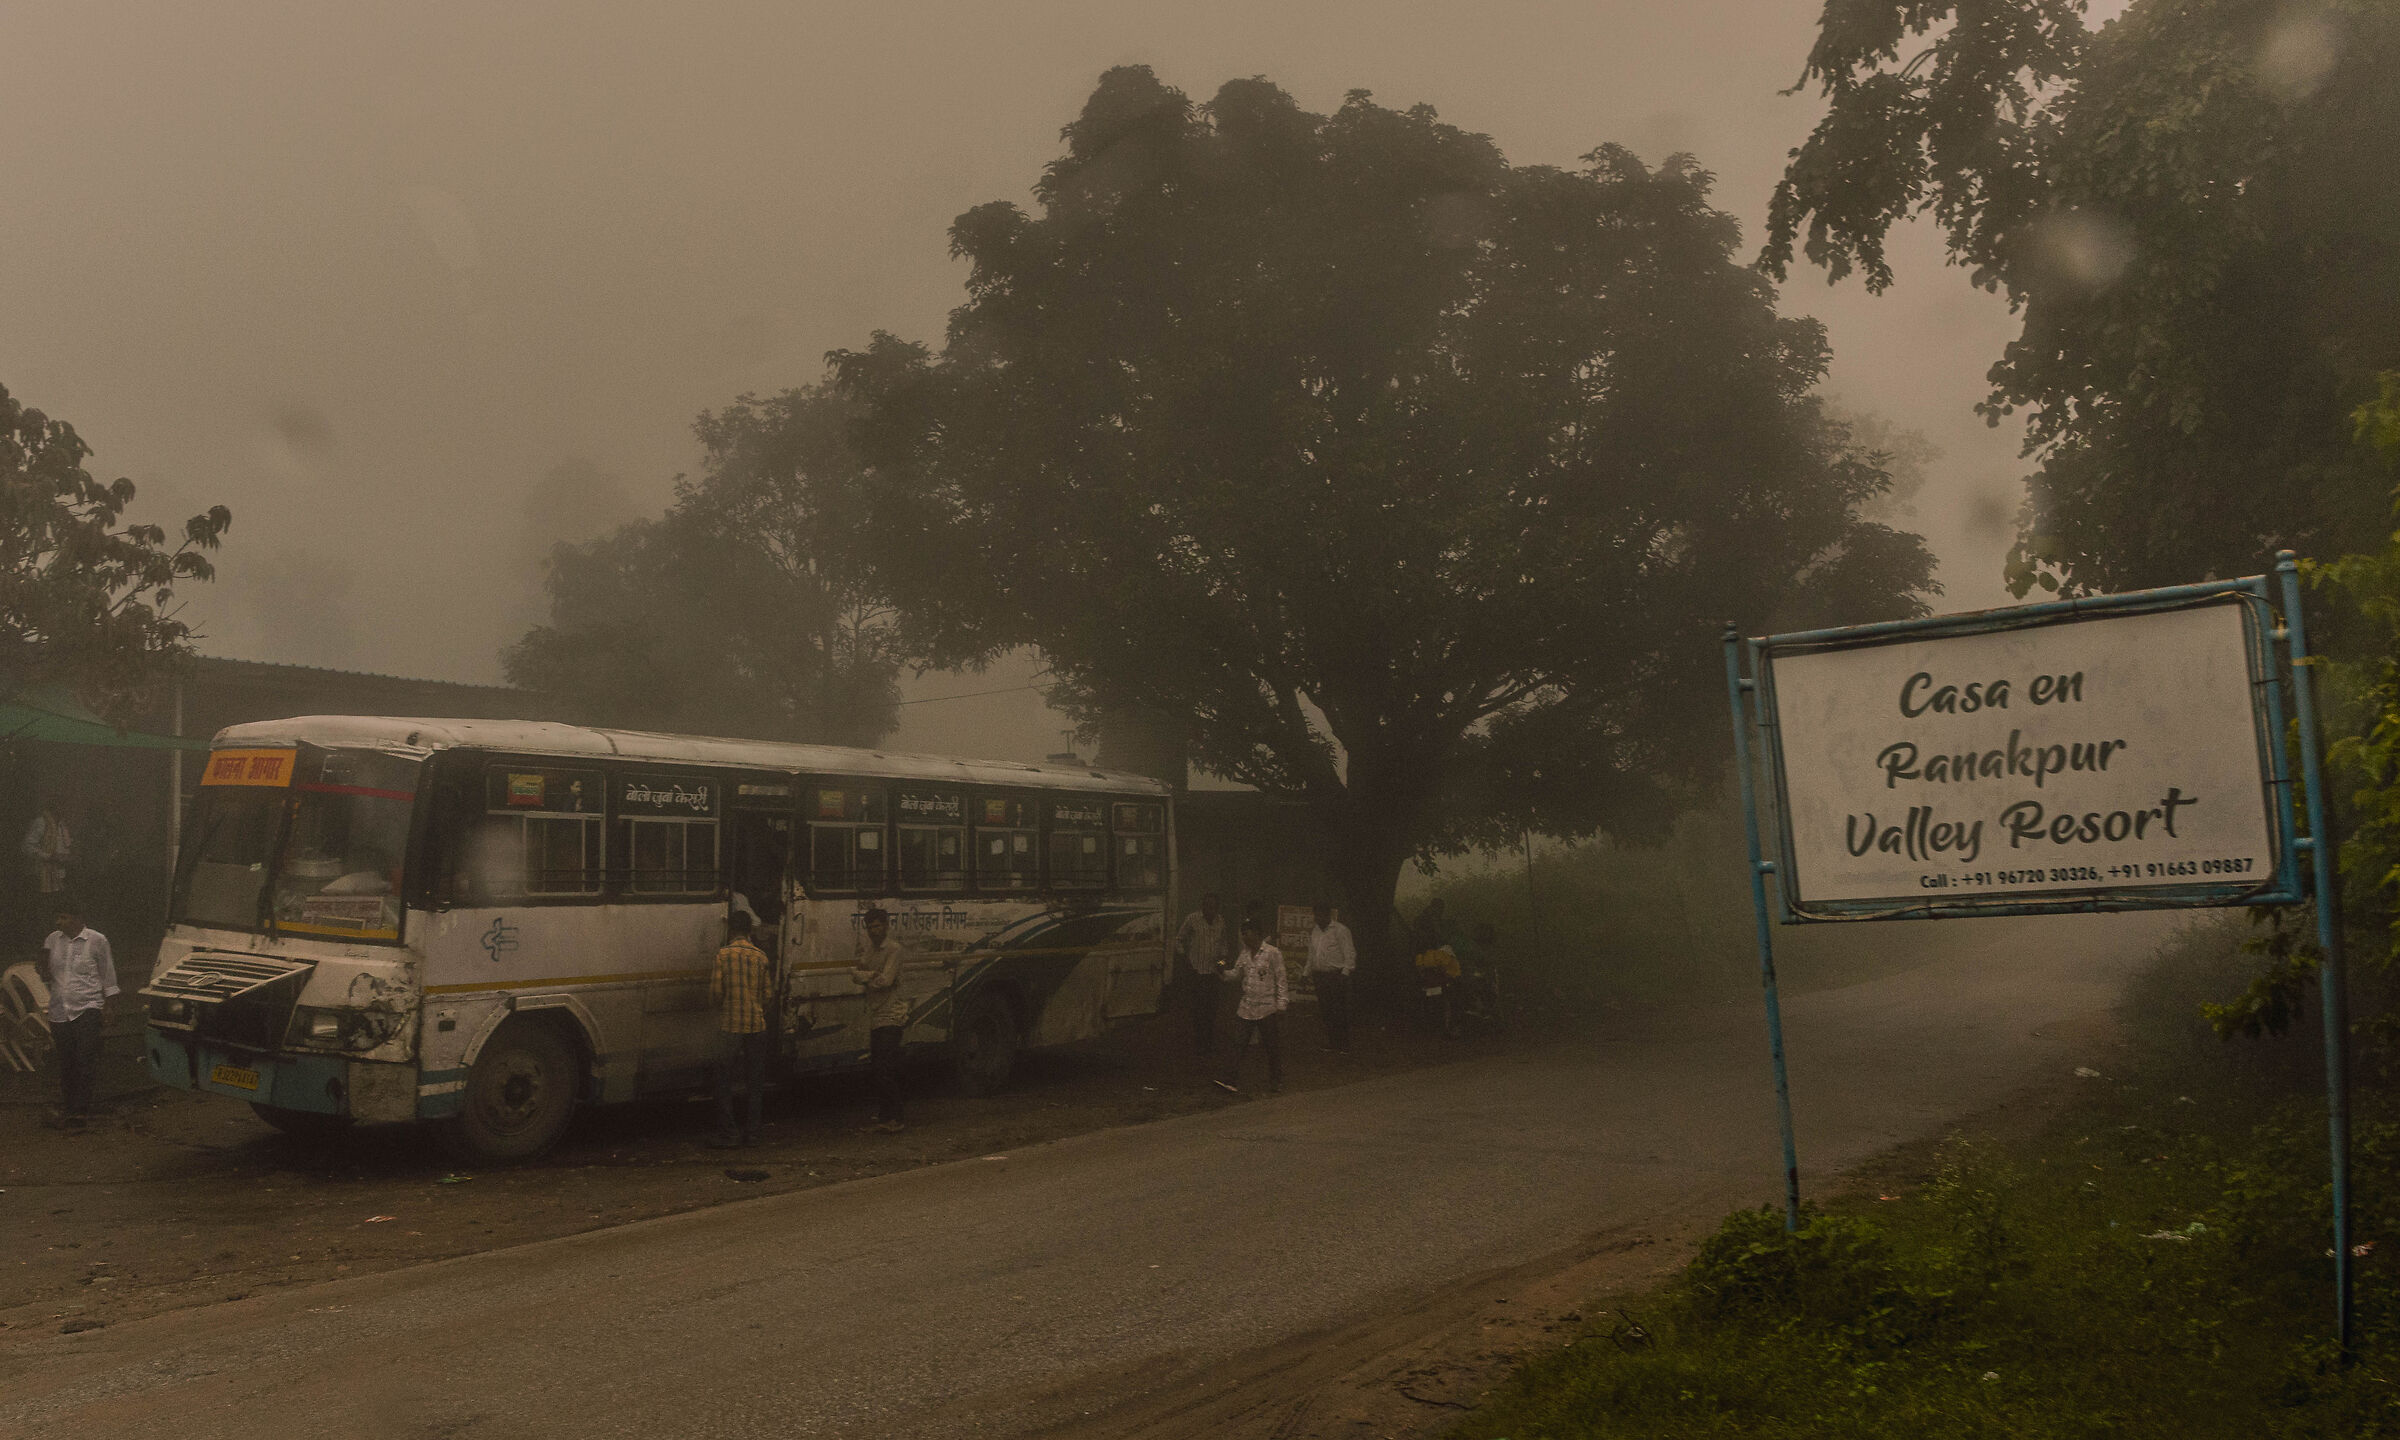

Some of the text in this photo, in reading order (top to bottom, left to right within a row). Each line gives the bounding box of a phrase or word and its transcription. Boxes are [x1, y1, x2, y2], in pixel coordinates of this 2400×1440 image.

[1901, 670, 2084, 719] Casa en
[1877, 729, 2127, 789] Ranakpur
[1846, 787, 2199, 863] Valley Resort
[1919, 875, 1948, 889] Call
[1961, 872, 1992, 887] +91
[1998, 869, 2045, 885] 96720
[2050, 866, 2103, 883] 30326,
[2107, 863, 2141, 879] +91
[2147, 861, 2197, 877] 91663
[2203, 857, 2254, 874] 09887
[942, 905, 968, 930] निगम
